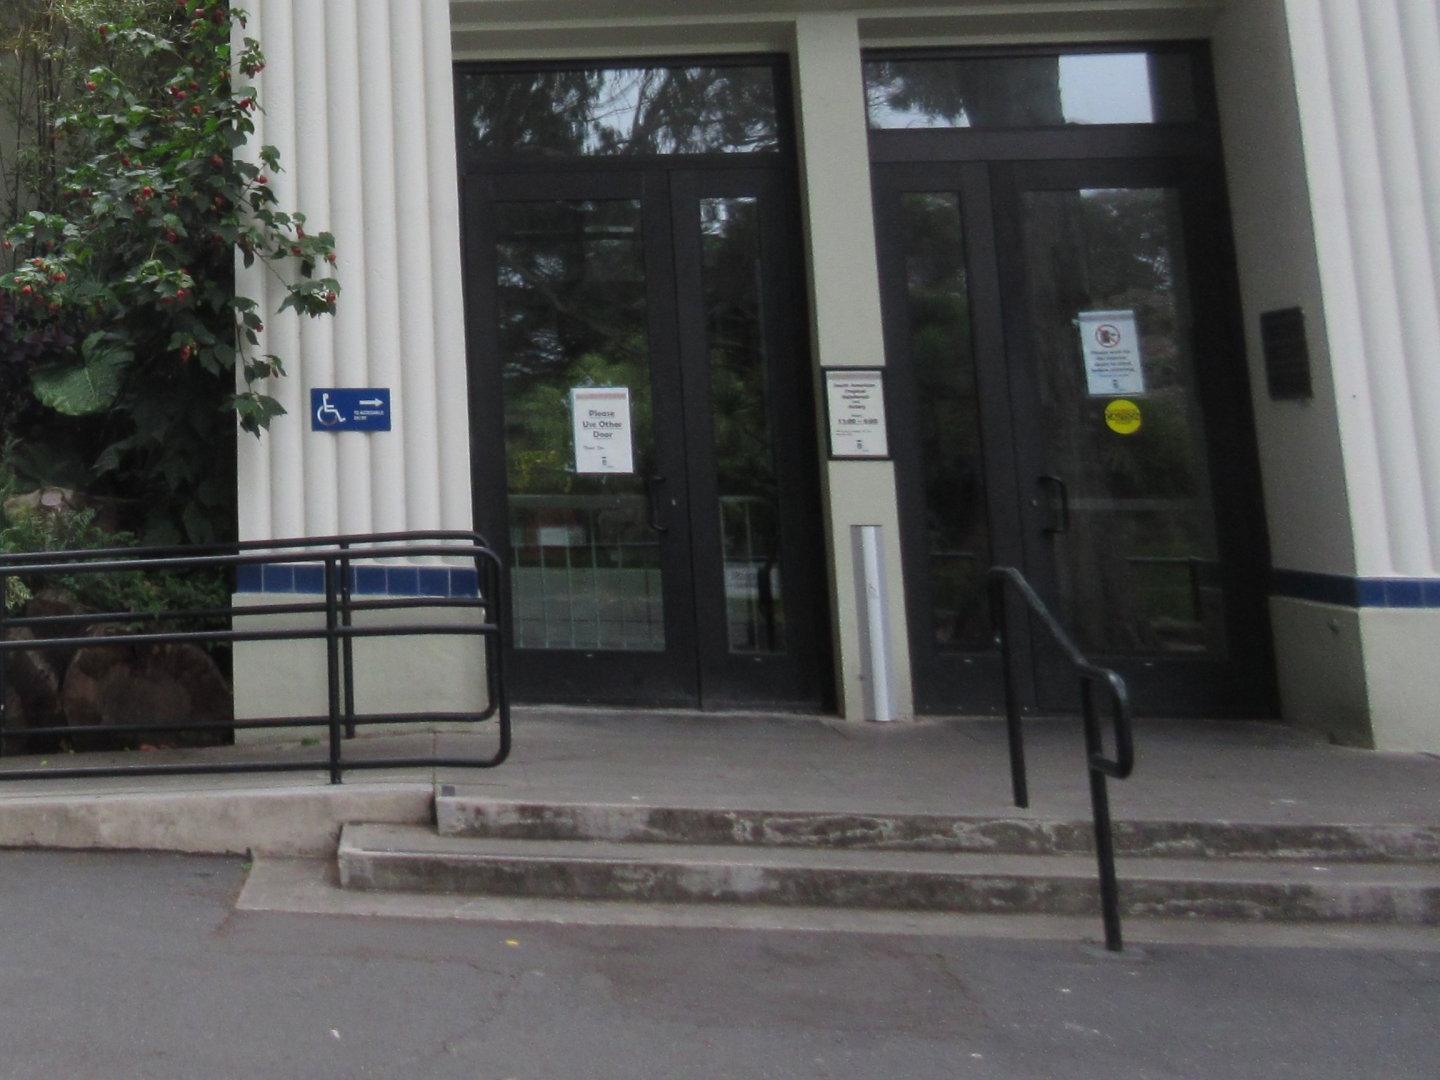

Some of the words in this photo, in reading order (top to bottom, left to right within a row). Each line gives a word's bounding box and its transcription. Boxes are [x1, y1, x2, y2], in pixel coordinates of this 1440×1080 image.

[588, 409, 615, 418] Please
[582, 420, 597, 428] Use
[599, 420, 623, 428] Other
[592, 430, 613, 438] Door
